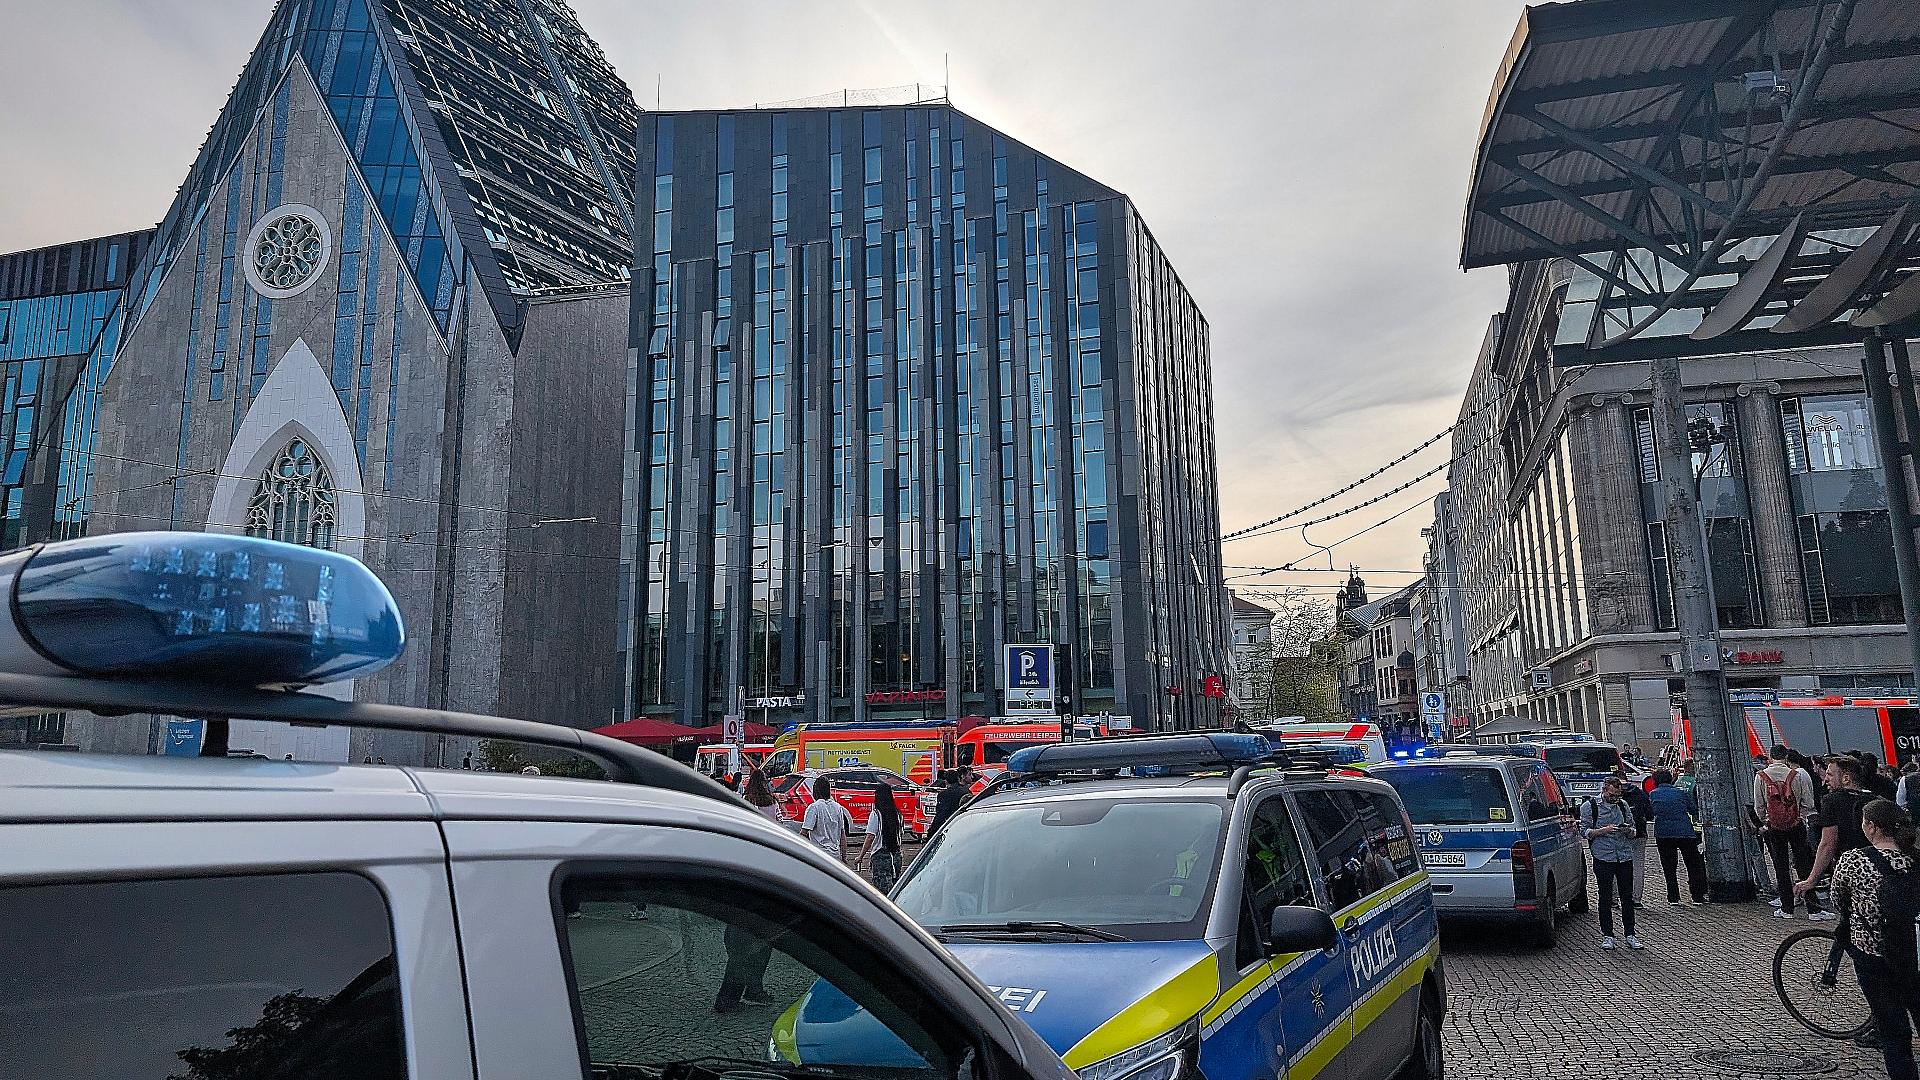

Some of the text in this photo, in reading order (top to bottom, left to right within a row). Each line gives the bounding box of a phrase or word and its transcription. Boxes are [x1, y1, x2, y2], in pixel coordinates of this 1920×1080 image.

[1807, 424, 1843, 432] WELLA
[1021, 655, 1035, 677] P
[756, 696, 792, 708] PASTA
[984, 732, 1062, 740] FEUERWEHR LEIPZIG
[1350, 921, 1397, 989] POLIZEI
